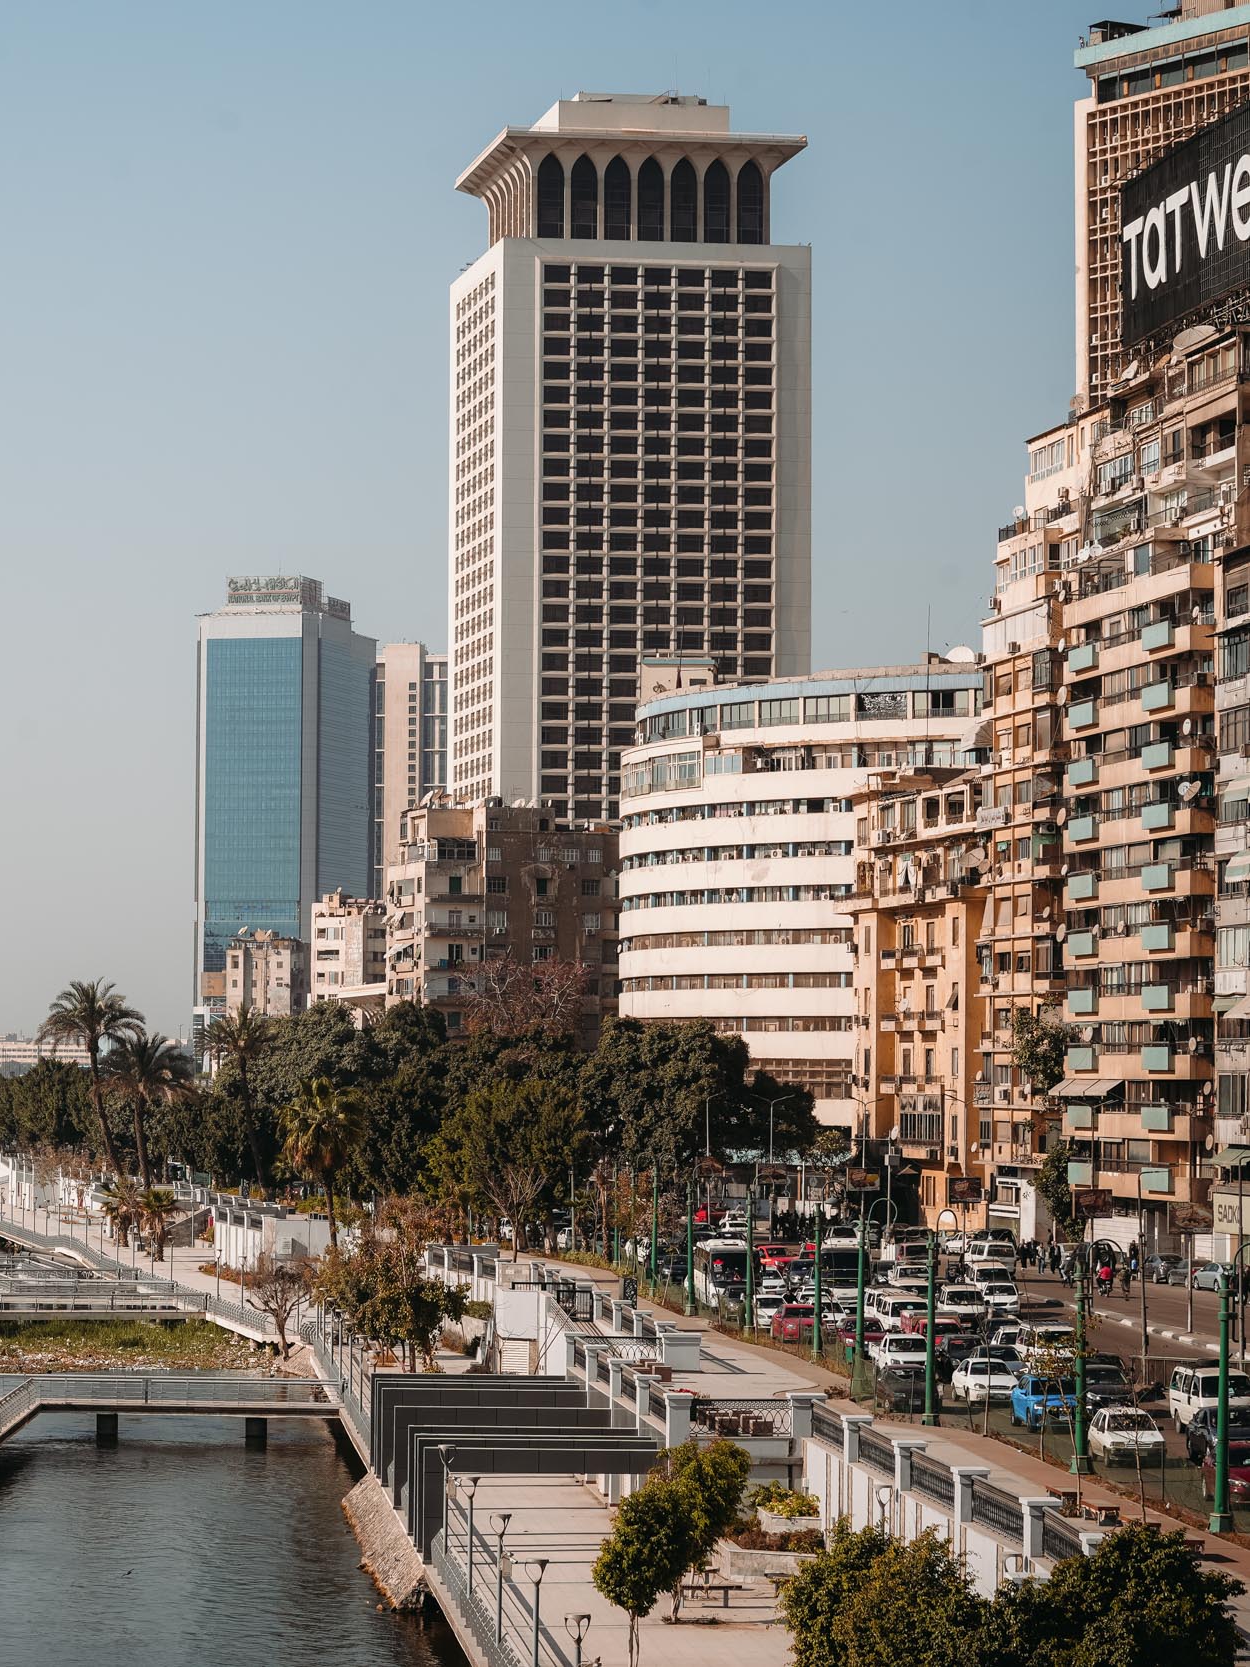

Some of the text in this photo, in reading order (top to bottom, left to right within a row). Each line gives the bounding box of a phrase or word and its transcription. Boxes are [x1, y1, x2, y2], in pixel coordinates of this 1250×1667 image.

[228, 593, 299, 603] NATIONAL BANK OF EGYPT
